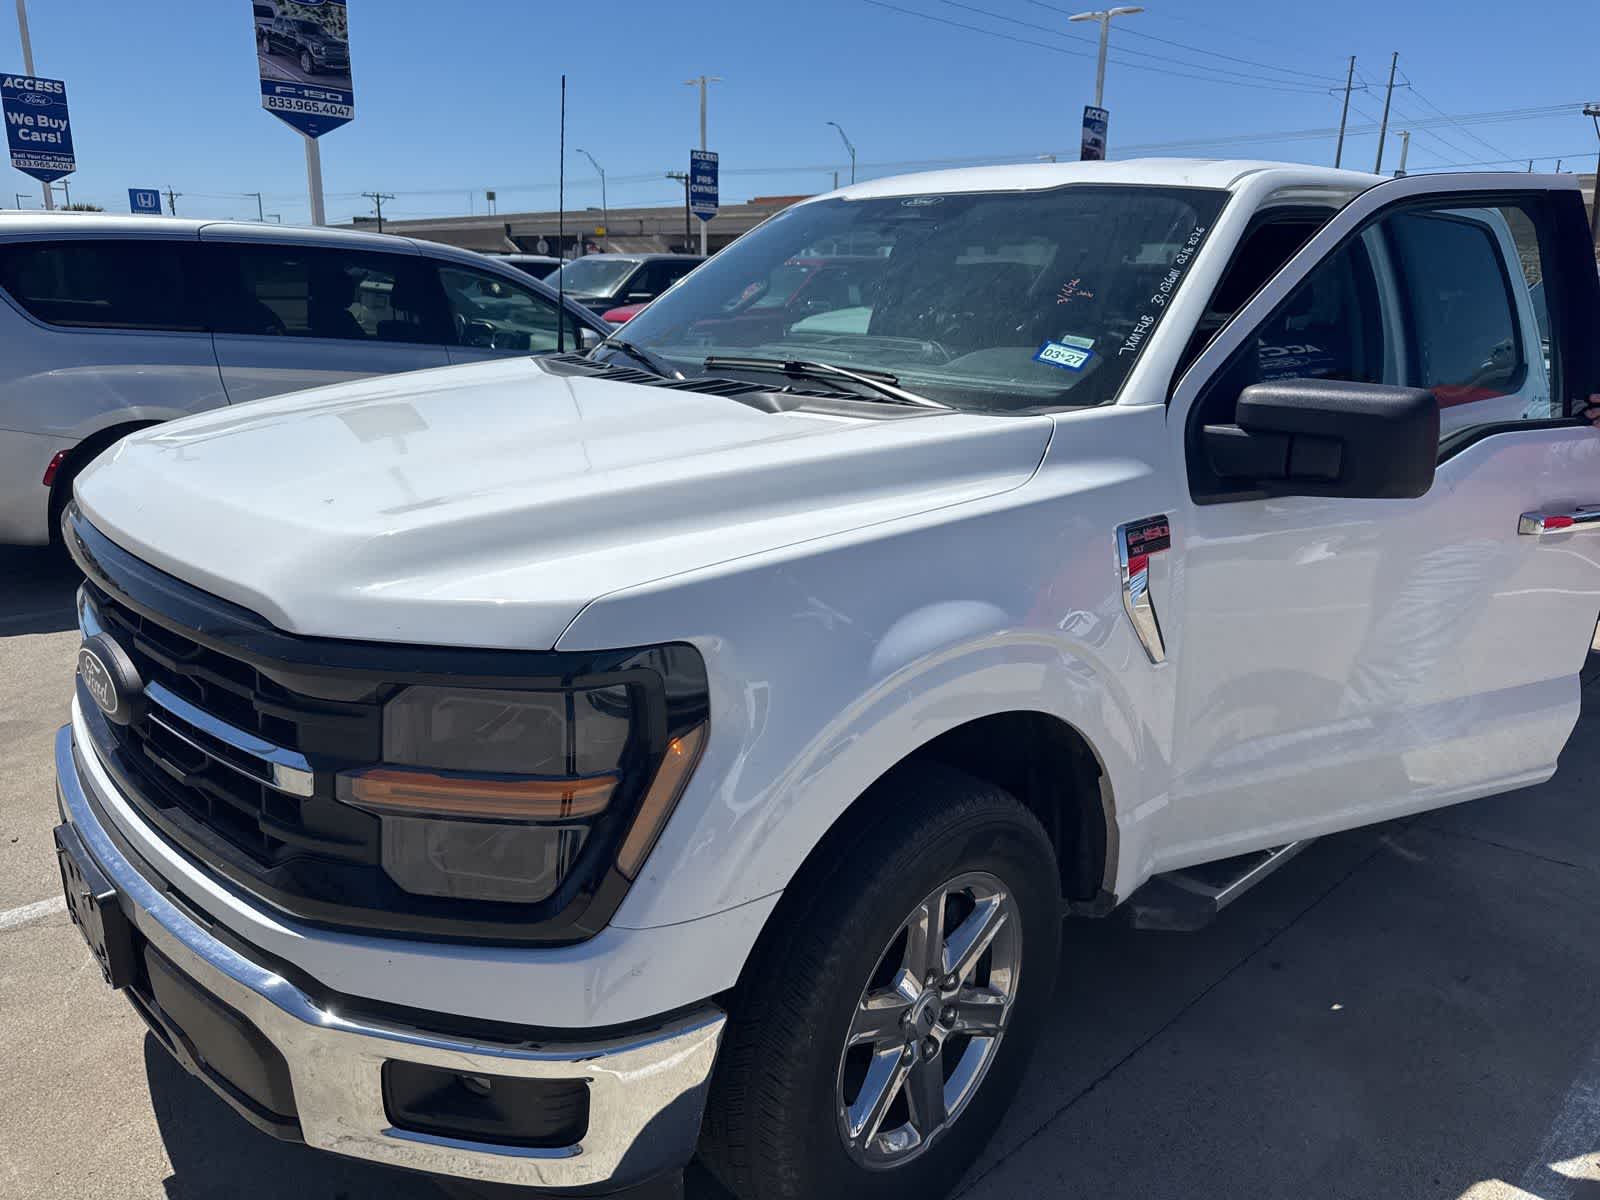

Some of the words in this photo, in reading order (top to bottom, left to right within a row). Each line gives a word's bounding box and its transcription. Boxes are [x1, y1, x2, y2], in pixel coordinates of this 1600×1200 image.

[3, 77, 63, 94] ACCESS
[275, 86, 343, 101] F-150
[25, 94, 47, 104] Ford
[268, 97, 350, 117] 833.965.4047
[7, 111, 34, 126] We
[37, 114, 67, 131] Buy
[18, 128, 62, 144] Cars!
[692, 152, 718, 161] ACCESS
[1044, 348, 1061, 359] 03
[1064, 354, 1083, 364] 27
[85, 655, 109, 706] Ford
